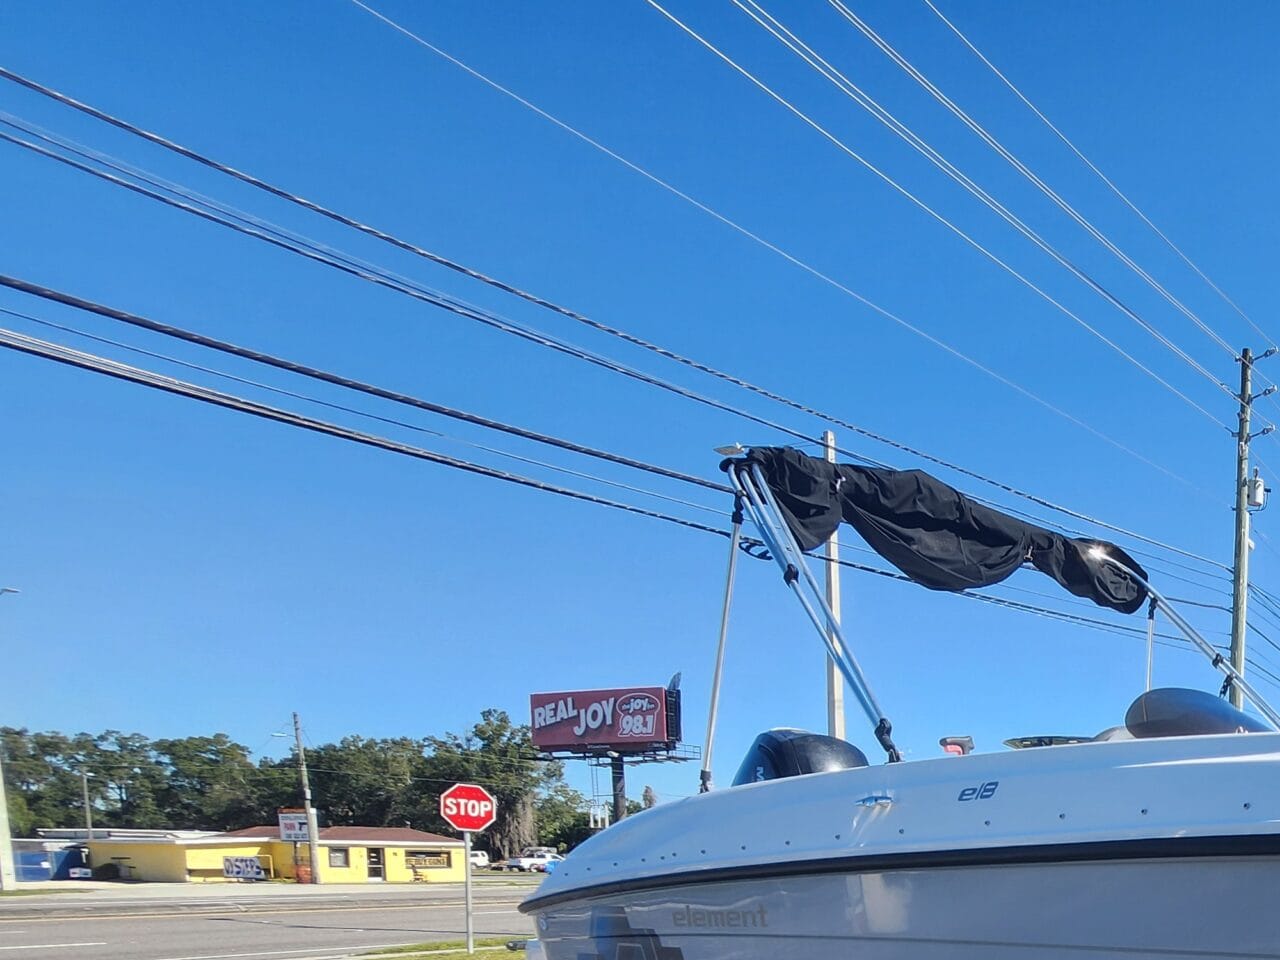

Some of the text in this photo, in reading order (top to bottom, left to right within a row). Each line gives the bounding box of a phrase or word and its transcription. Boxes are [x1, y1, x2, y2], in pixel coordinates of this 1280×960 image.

[533, 697, 614, 736] REAL JOY
[622, 715, 654, 734] 98.1
[445, 797, 492, 817] STOP
[672, 904, 769, 928] element
